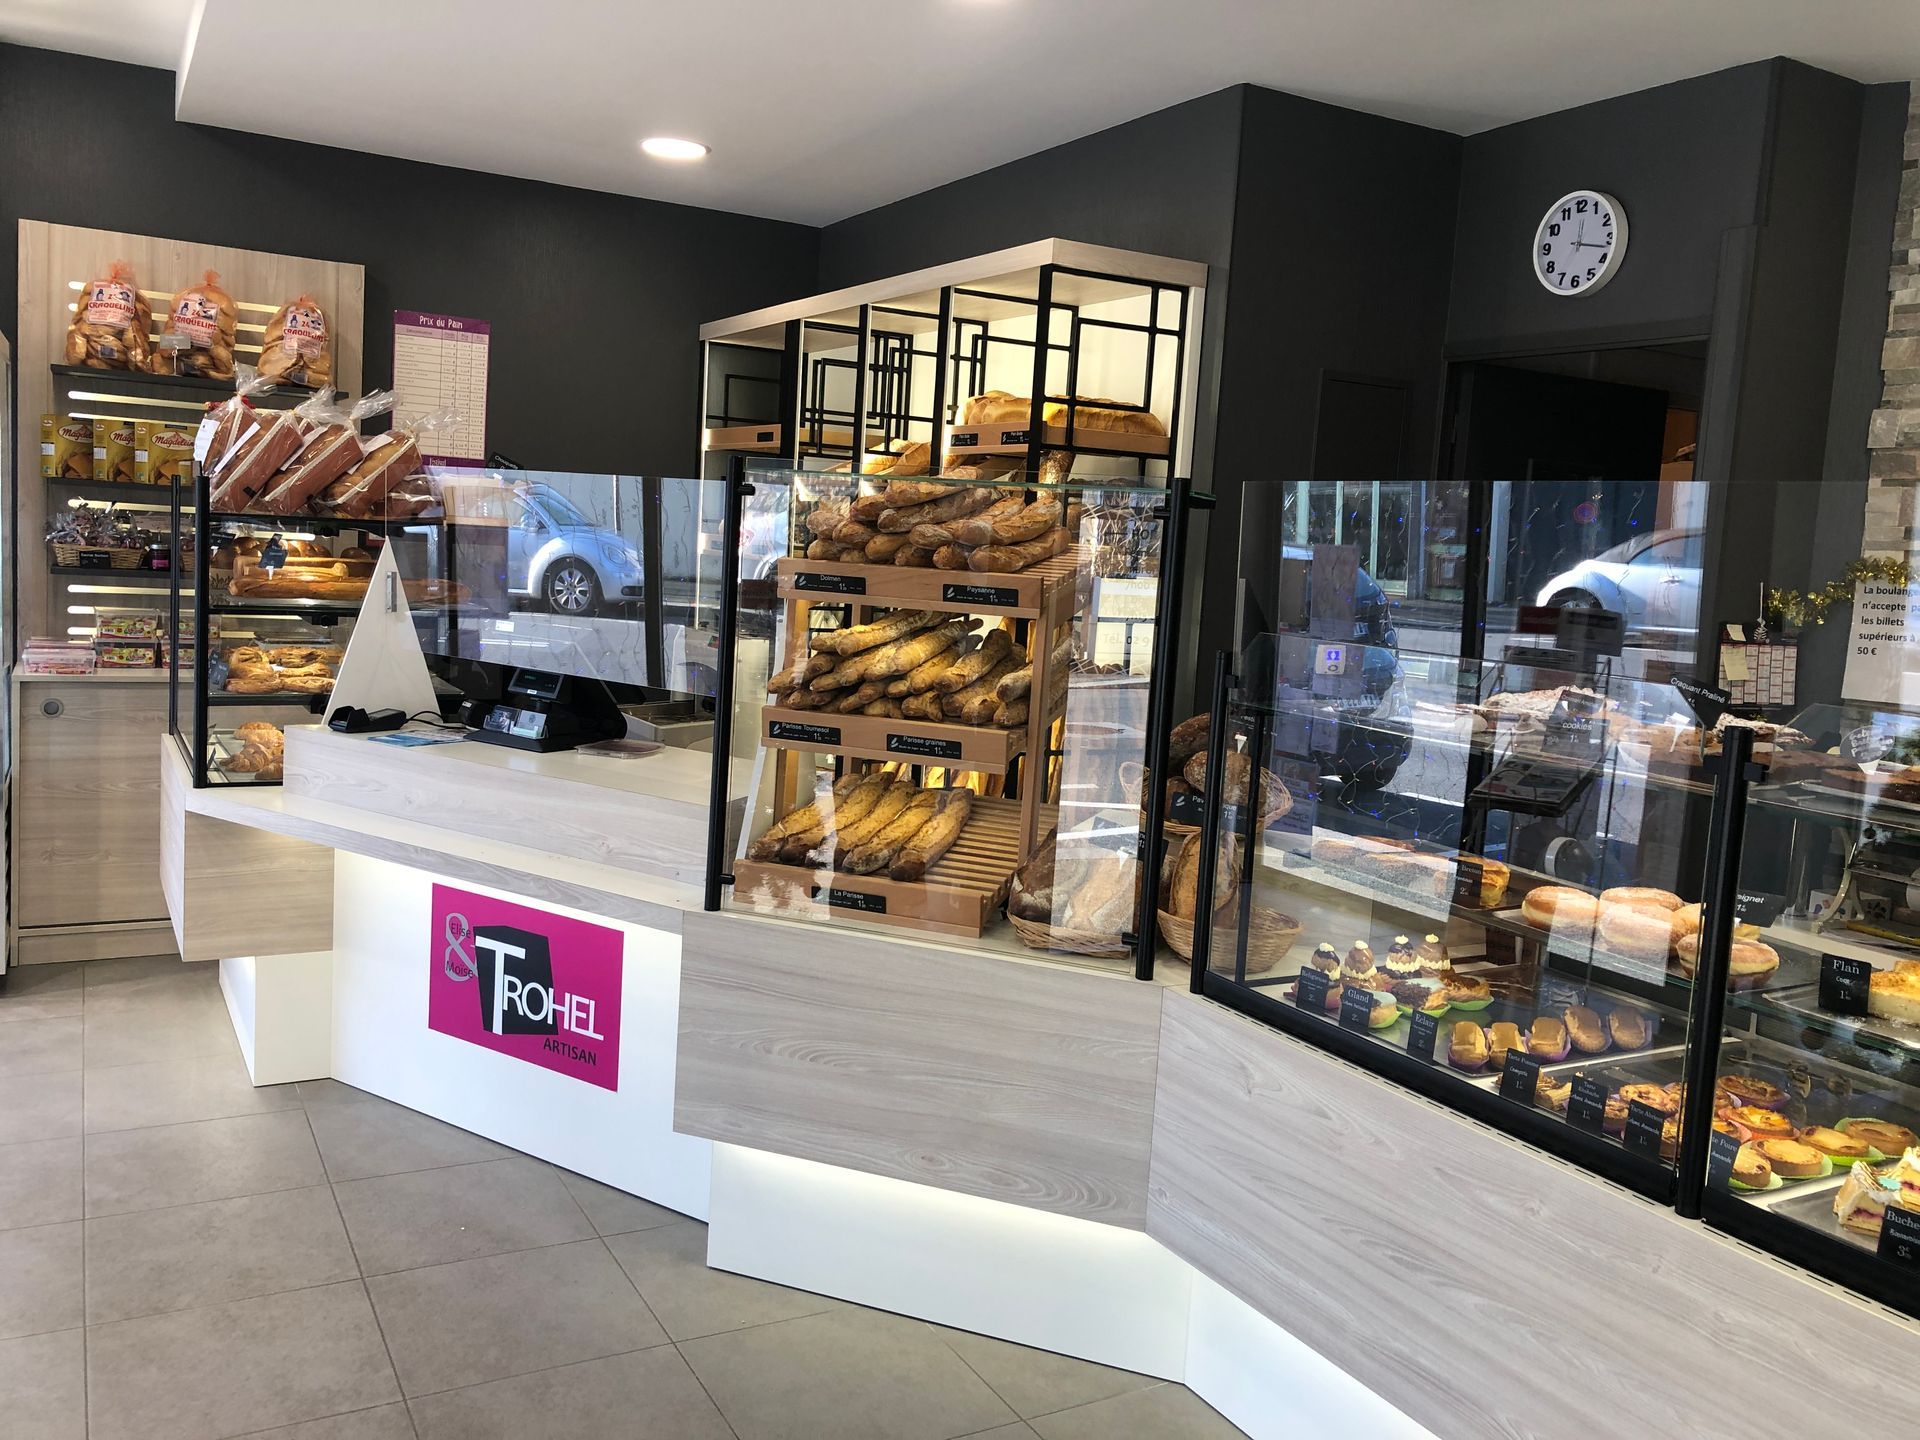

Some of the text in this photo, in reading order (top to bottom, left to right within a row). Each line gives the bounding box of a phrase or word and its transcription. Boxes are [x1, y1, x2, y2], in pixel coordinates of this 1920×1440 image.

[1575, 199, 1588, 213] 12
[1593, 201, 1599, 214] 1
[1561, 207, 1571, 221] 11
[1602, 213, 1611, 227] 2
[1549, 223, 1561, 237] 10
[1606, 232, 1613, 245] 3
[1543, 243, 1551, 256] 9
[1598, 252, 1608, 264] 4
[1546, 261, 1555, 274] 8
[1558, 272, 1566, 286] 7
[1586, 268, 1596, 281] 5
[1571, 275, 1580, 288] 6
[88, 301, 135, 315] CRAQUELINS
[191, 309, 201, 318] 24
[174, 315, 217, 331] CRAQUELINS
[301, 320, 311, 328] 24
[419, 315, 463, 330] Prix du Pain
[283, 328, 325, 343] CRAQUELINS
[820, 574, 841, 582] Dolmen
[967, 585, 996, 595] Paysanne
[1864, 586, 1875, 595] La
[1862, 601, 1906, 613] n'accepte
[1861, 616, 1905, 627] les billets
[1858, 631, 1907, 643] supérieurs
[1857, 647, 1878, 656] 50 €
[1670, 677, 1726, 704] Craquant Praliné
[803, 724, 830, 733] Tournesol
[1562, 721, 1593, 730] cookies
[903, 736, 947, 747] Parisse graines
[843, 891, 864, 900] Parisse
[451, 922, 471, 938] Elise
[1833, 960, 1860, 974] Flan
[475, 935, 604, 1042] TROHEL
[1348, 989, 1370, 1003] Gland
[543, 1037, 597, 1066] ARTISAN
